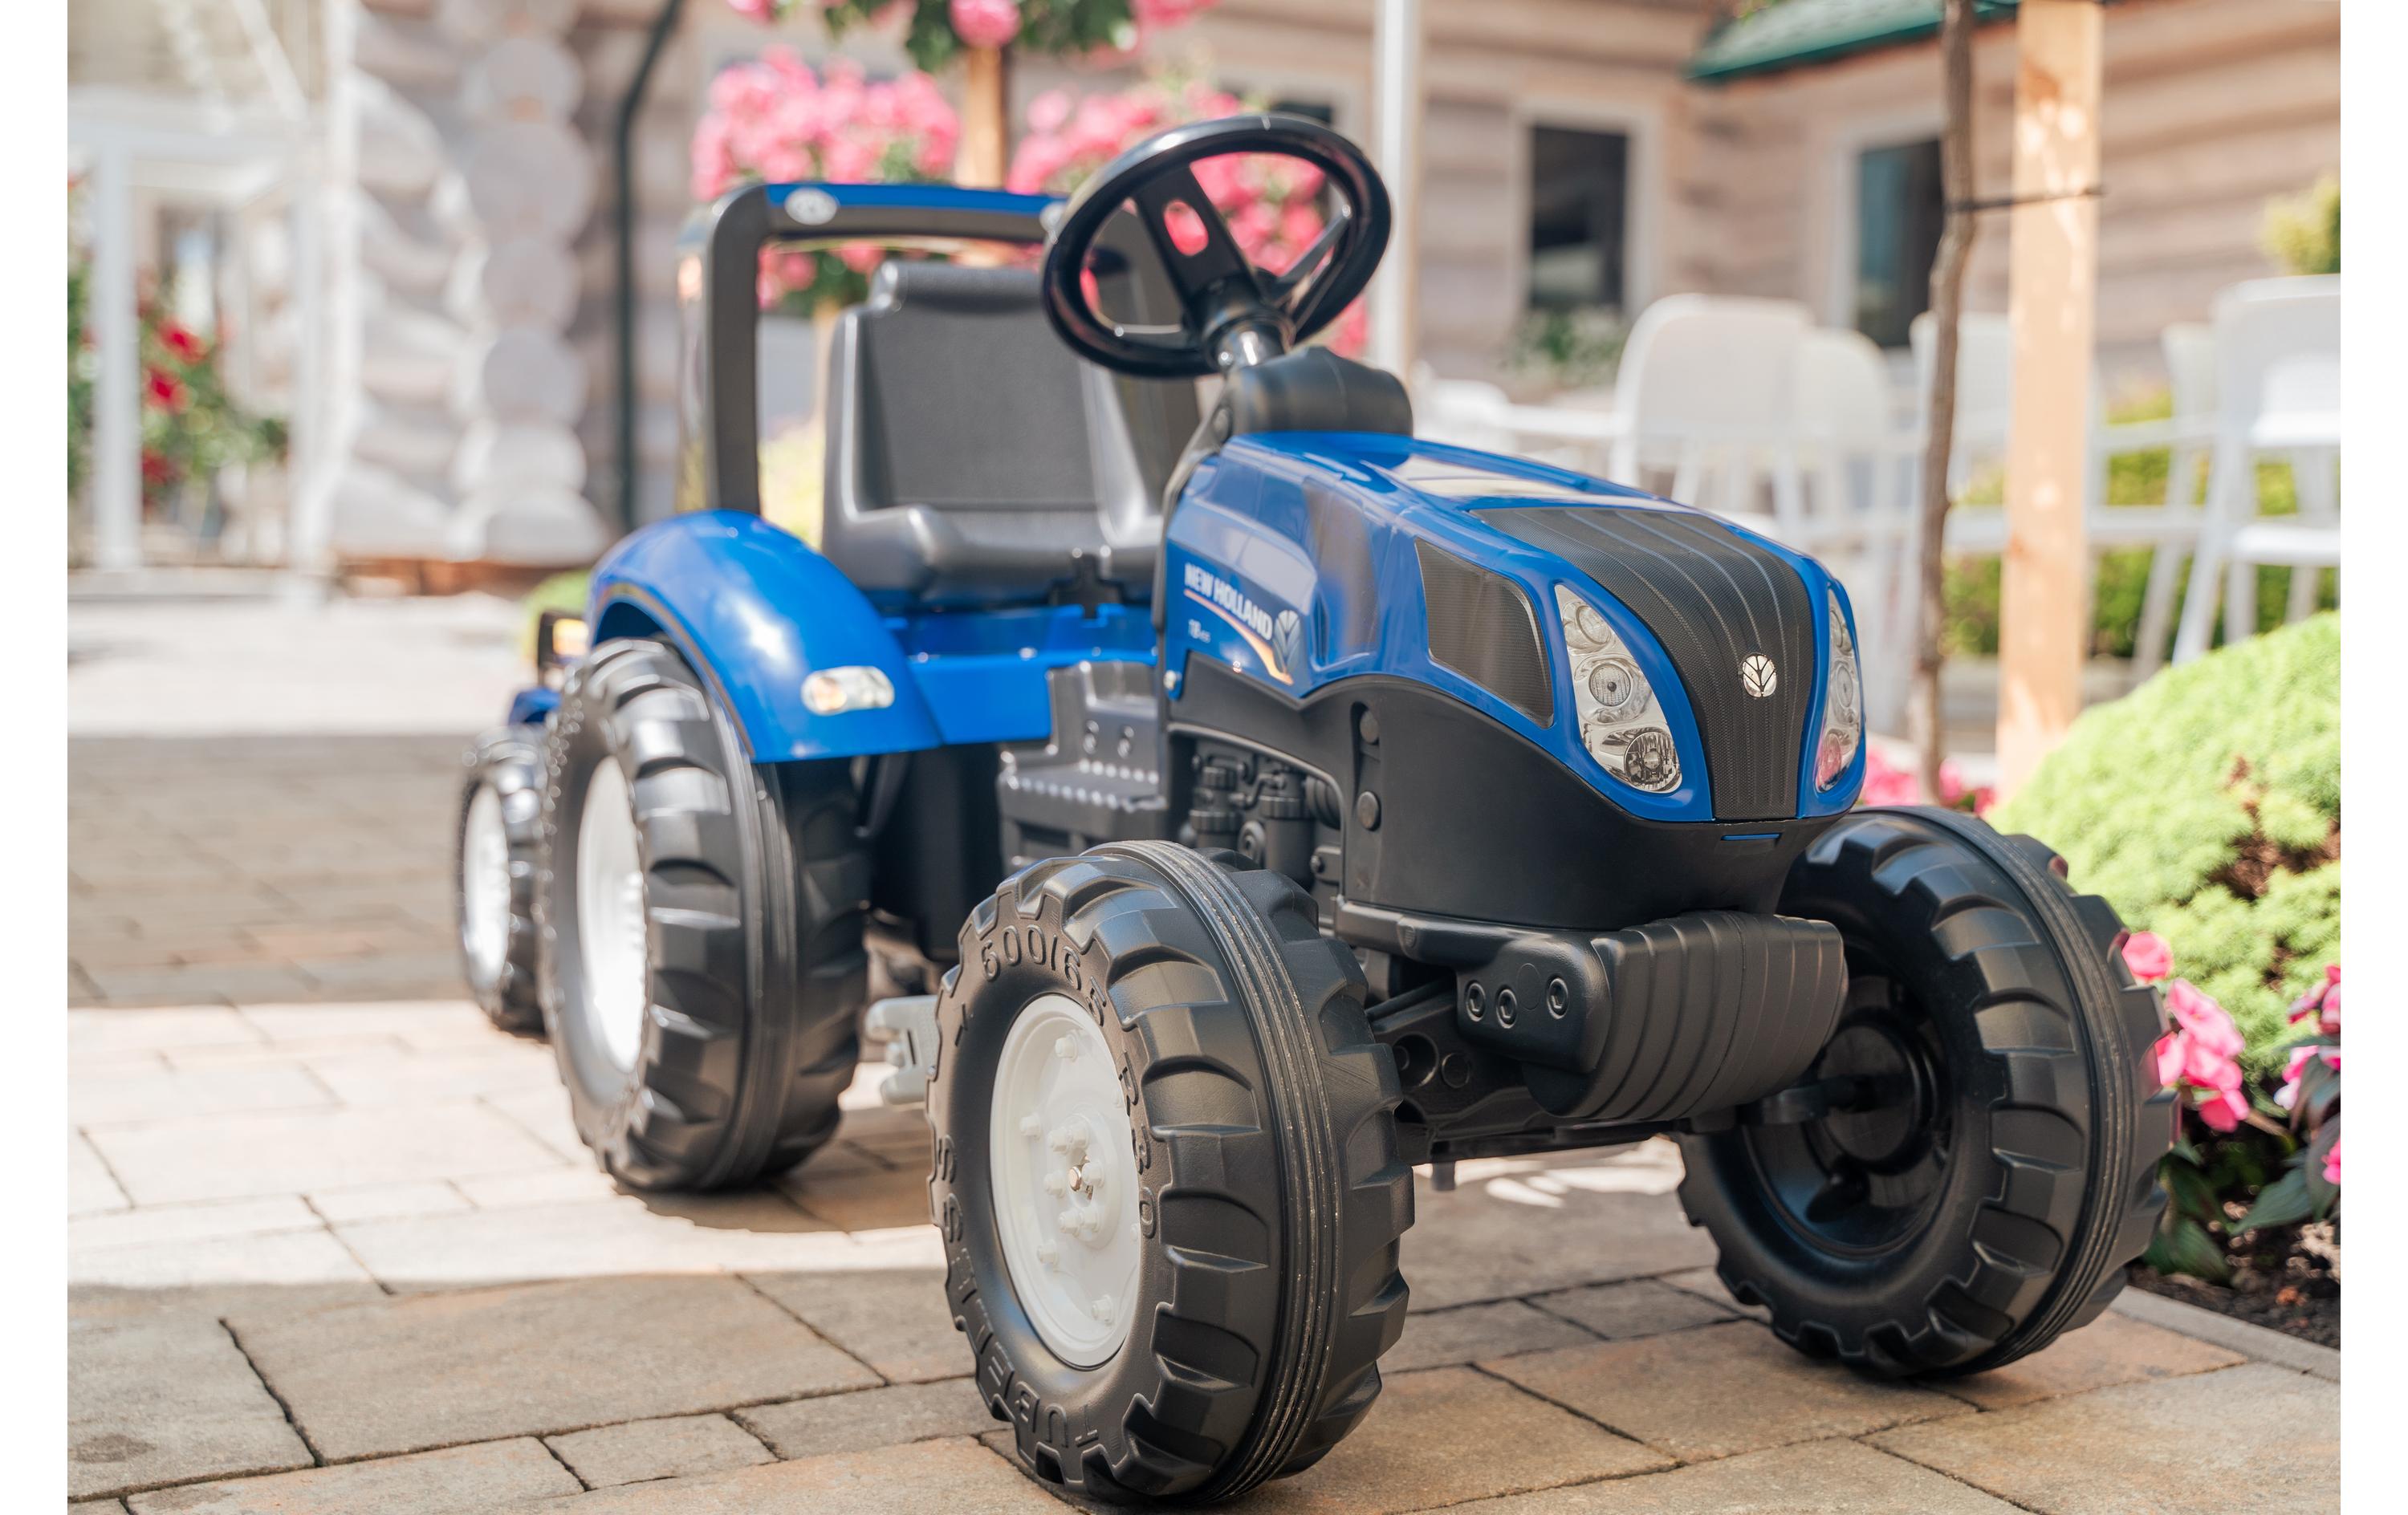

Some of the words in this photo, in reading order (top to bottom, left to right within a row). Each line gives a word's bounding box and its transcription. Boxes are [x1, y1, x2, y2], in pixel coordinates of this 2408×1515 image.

[1185, 563, 1214, 597] NEW
[1214, 578, 1273, 640] HOLLAND
[938, 1135, 1099, 1447] TUBELESS
